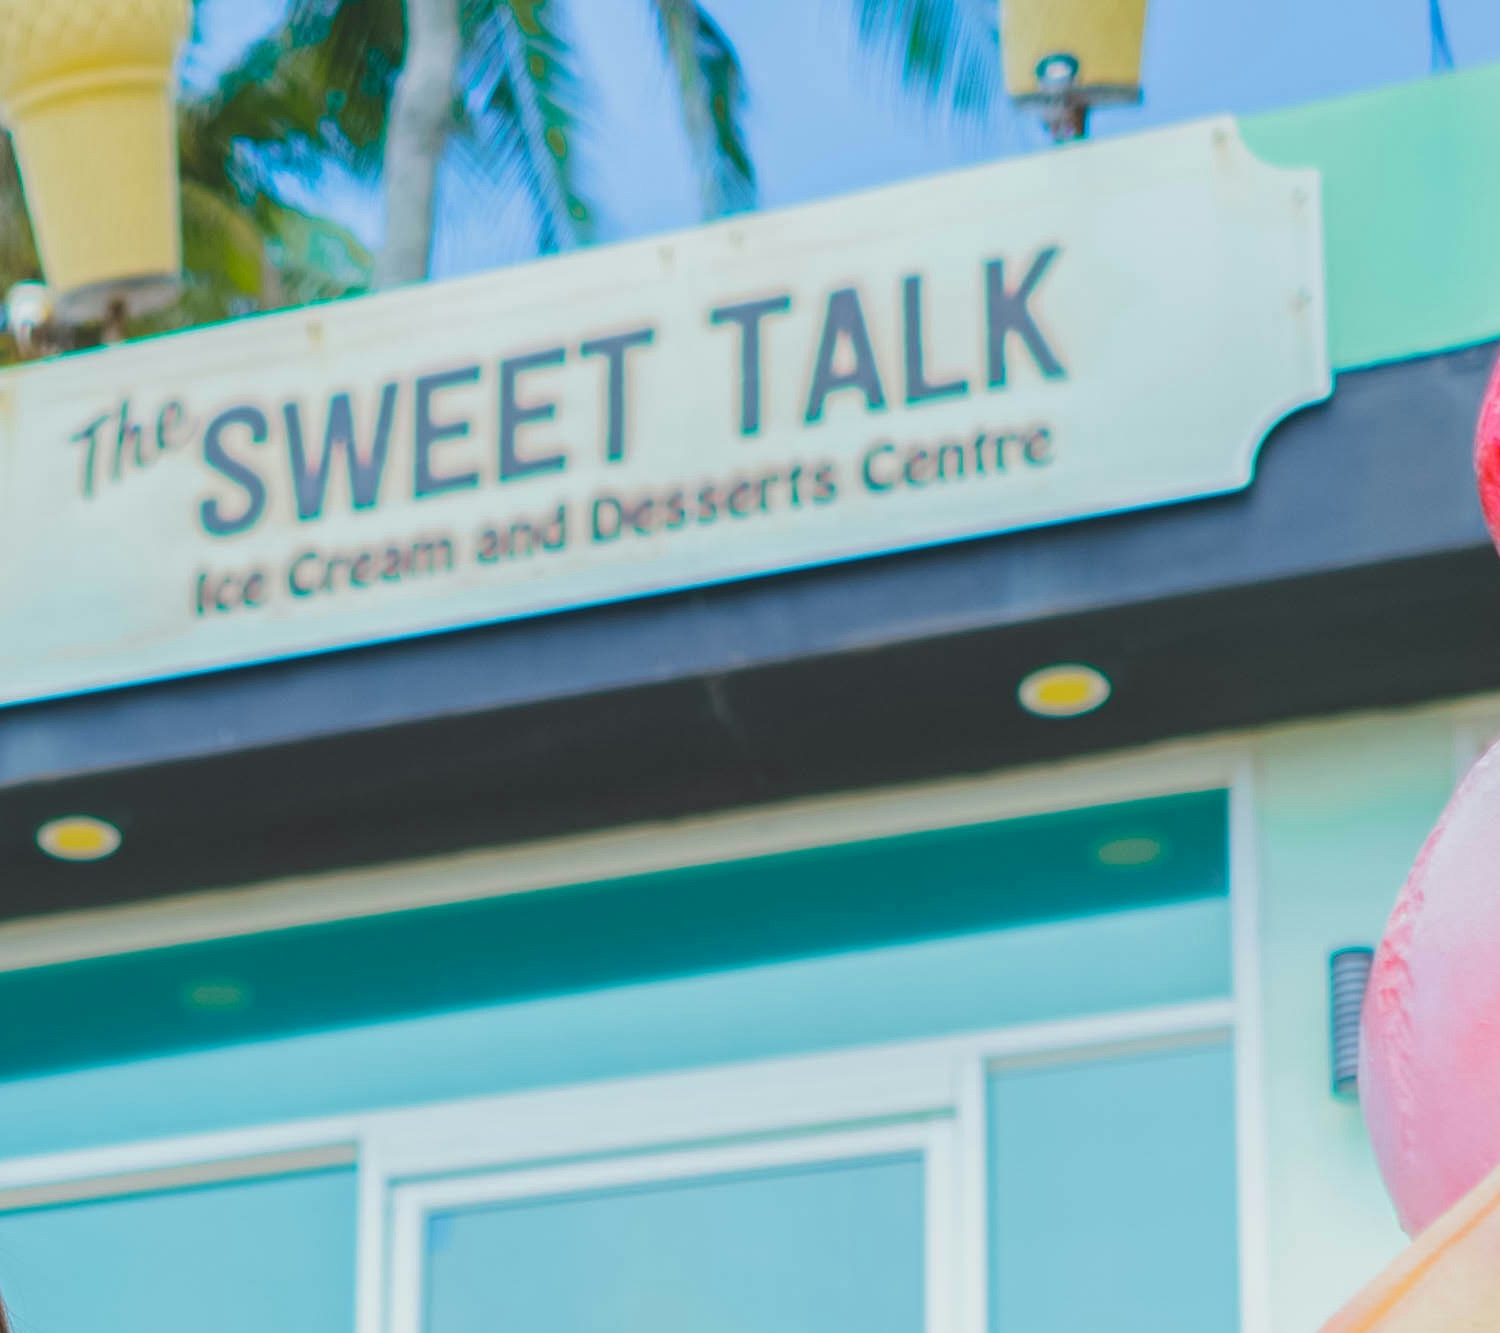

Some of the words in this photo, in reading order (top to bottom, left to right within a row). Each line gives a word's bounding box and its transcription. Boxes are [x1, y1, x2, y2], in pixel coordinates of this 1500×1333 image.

[71, 396, 185, 498] The
[200, 327, 655, 536] SWEET
[710, 245, 1067, 437] TALK
[196, 571, 264, 617] Ice
[288, 537, 454, 598] Cream
[477, 503, 567, 565] and
[591, 460, 837, 543] Desserts
[861, 425, 1054, 494] Centre
